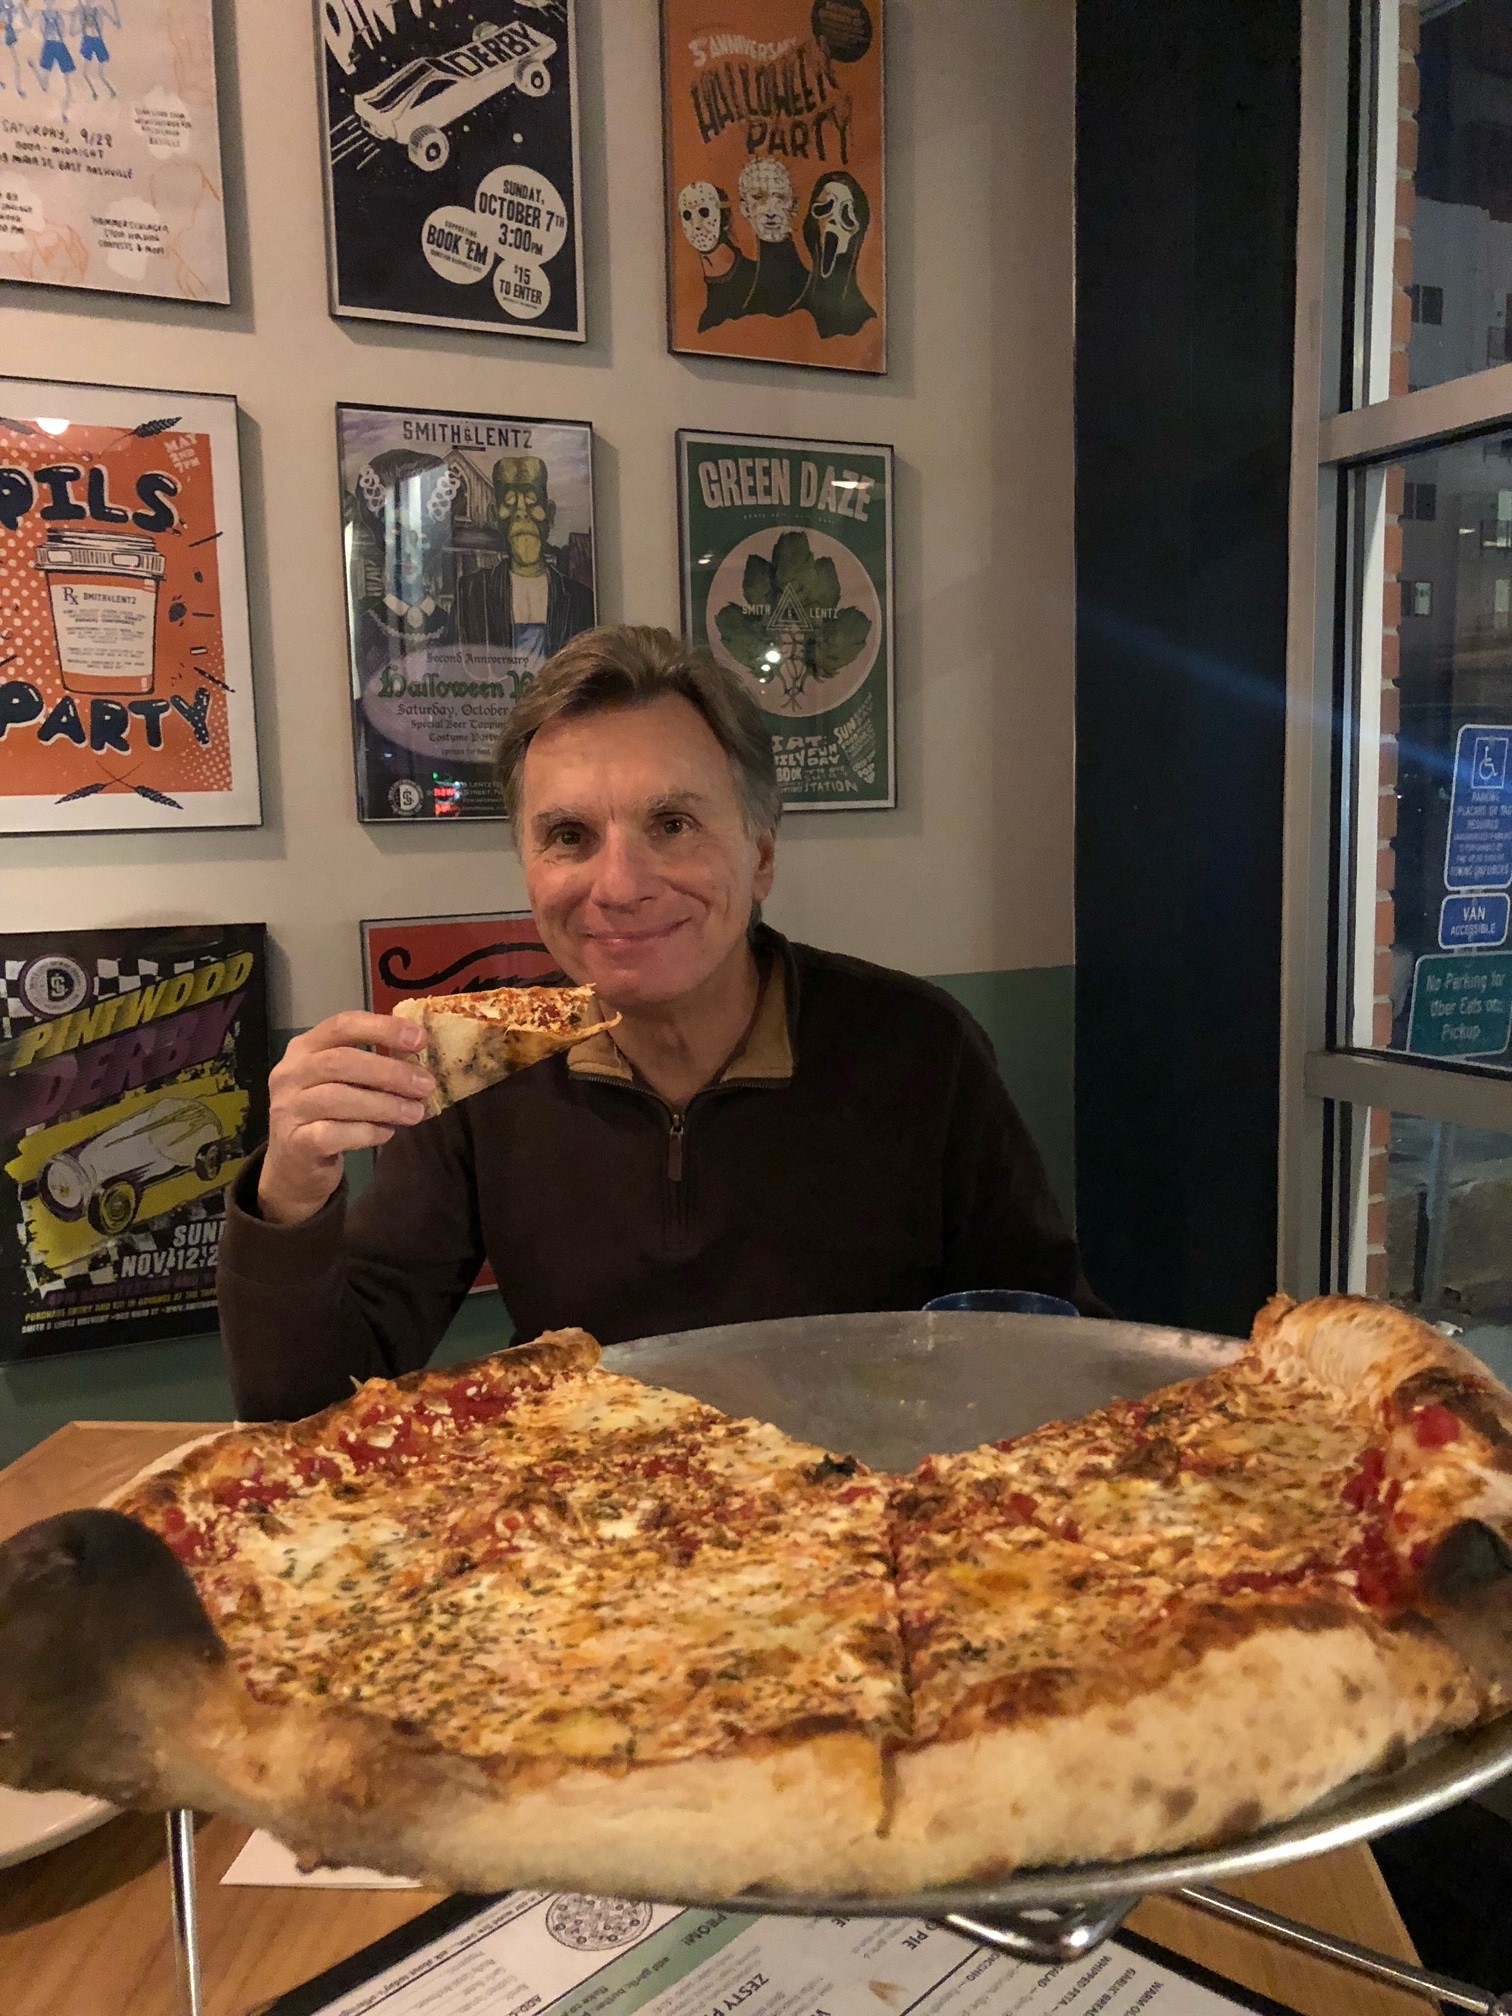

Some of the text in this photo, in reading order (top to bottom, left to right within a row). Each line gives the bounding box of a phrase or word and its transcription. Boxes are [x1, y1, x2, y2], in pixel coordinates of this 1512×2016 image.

[444, 22, 541, 78] DERBY
[746, 92, 853, 165] PARTY
[503, 179, 545, 205] SUNDAY,
[478, 192, 541, 229] OCTOBER
[426, 224, 461, 256] BOOK
[514, 264, 531, 285] $15
[499, 279, 511, 296] TO
[513, 284, 543, 305] ENTER
[163, 433, 198, 454] MAY
[699, 457, 876, 523] GREEN DAZE
[741, 604, 771, 615] SMITH
[809, 607, 839, 619] LENTZ
[426, 651, 530, 668] Second Anniversary
[0, 680, 212, 752] PARTY
[396, 701, 509, 722] Saturday, October
[410, 719, 444, 730] Special
[446, 719, 467, 729] Beer
[428, 732, 468, 743] Costume
[1463, 907, 1486, 921] VAN
[1450, 922, 1496, 936] ACCESSIBLE
[1443, 972, 1488, 993] Parking
[10, 952, 254, 1070] PINTWOOD
[1459, 996, 1482, 1015] Eats
[1441, 1023, 1481, 1041] Pickup
[902, 1929, 929, 1951] PIE
[722, 1972, 770, 2011] ZESTY
[1057, 1955, 1113, 2007] WHIPPED FETA
[1108, 1967, 1137, 1997] GARLIC
[1137, 1981, 1164, 2008] WARM
